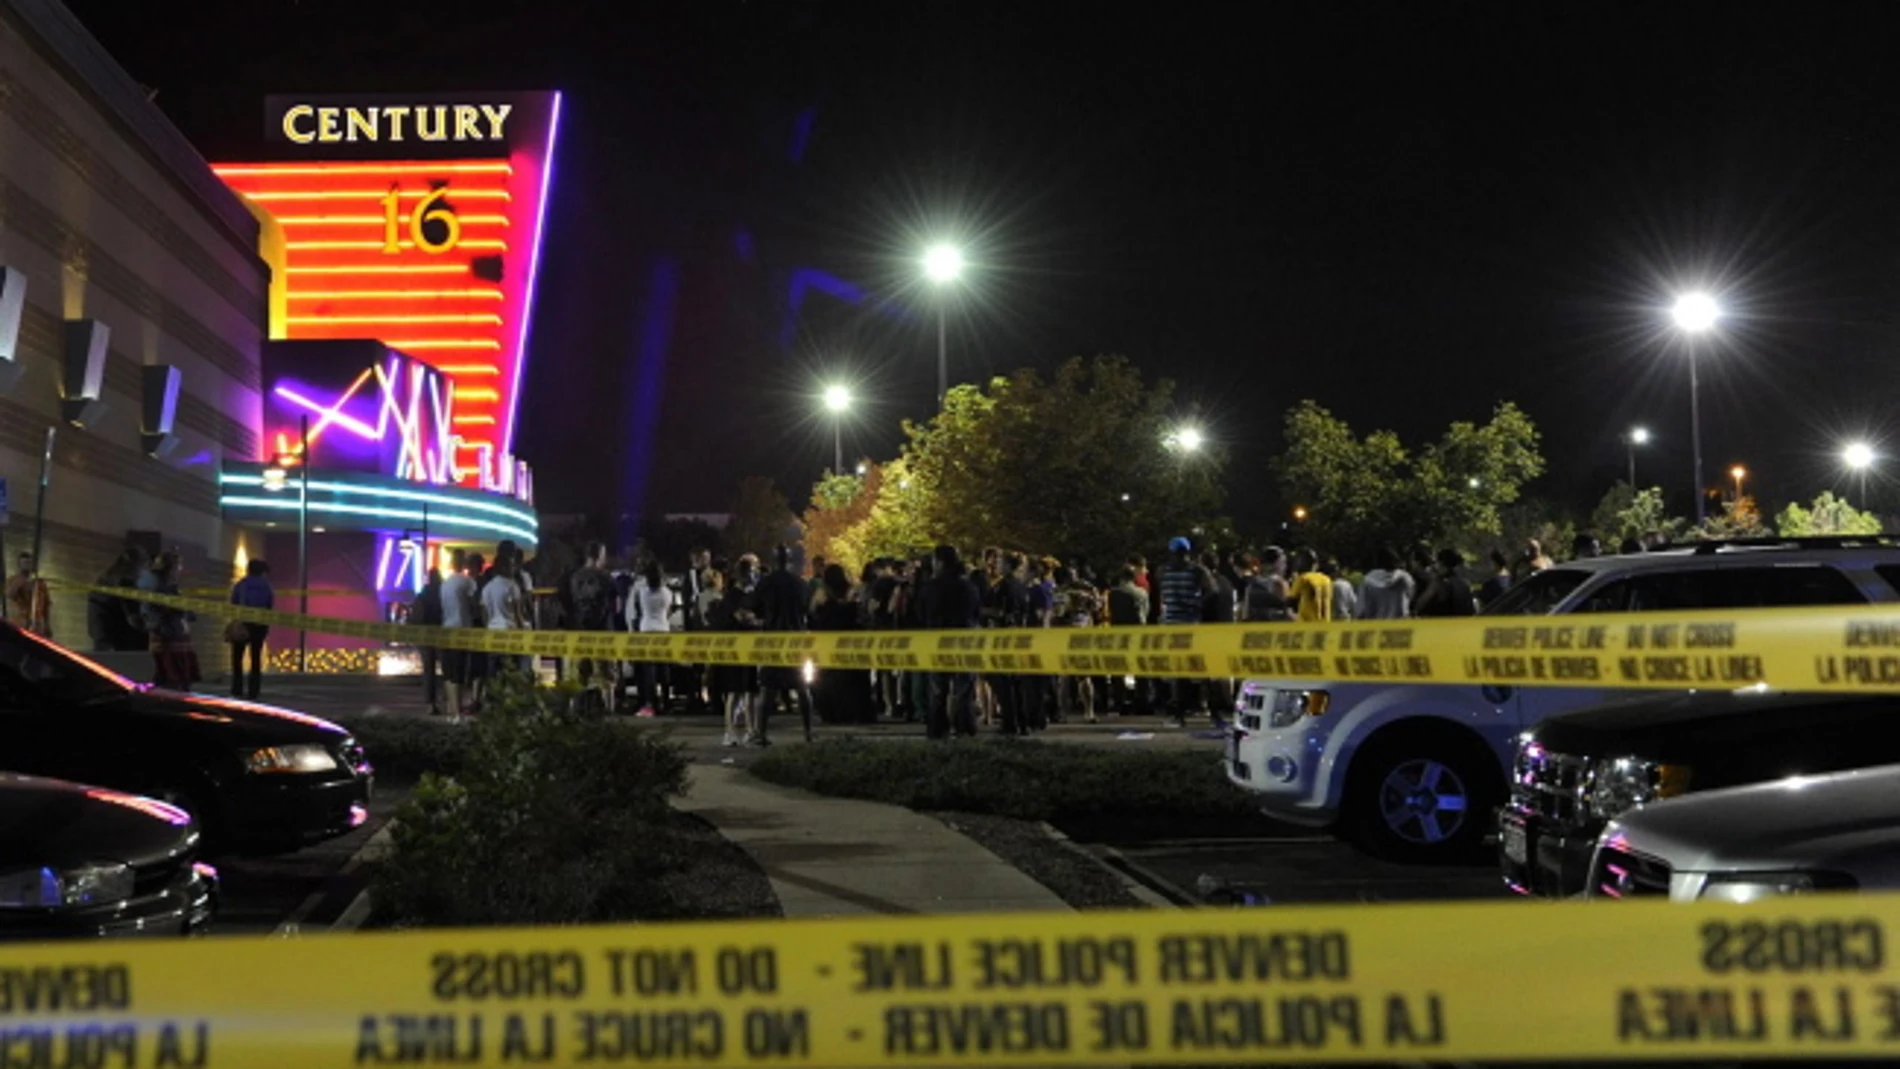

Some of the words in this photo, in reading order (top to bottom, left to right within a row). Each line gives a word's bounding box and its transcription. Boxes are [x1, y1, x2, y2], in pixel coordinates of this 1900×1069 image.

[282, 104, 512, 143] CENTURY
[380, 187, 460, 254] 16
[1686, 622, 1736, 648] CROSS
[1816, 655, 1839, 683] LA
